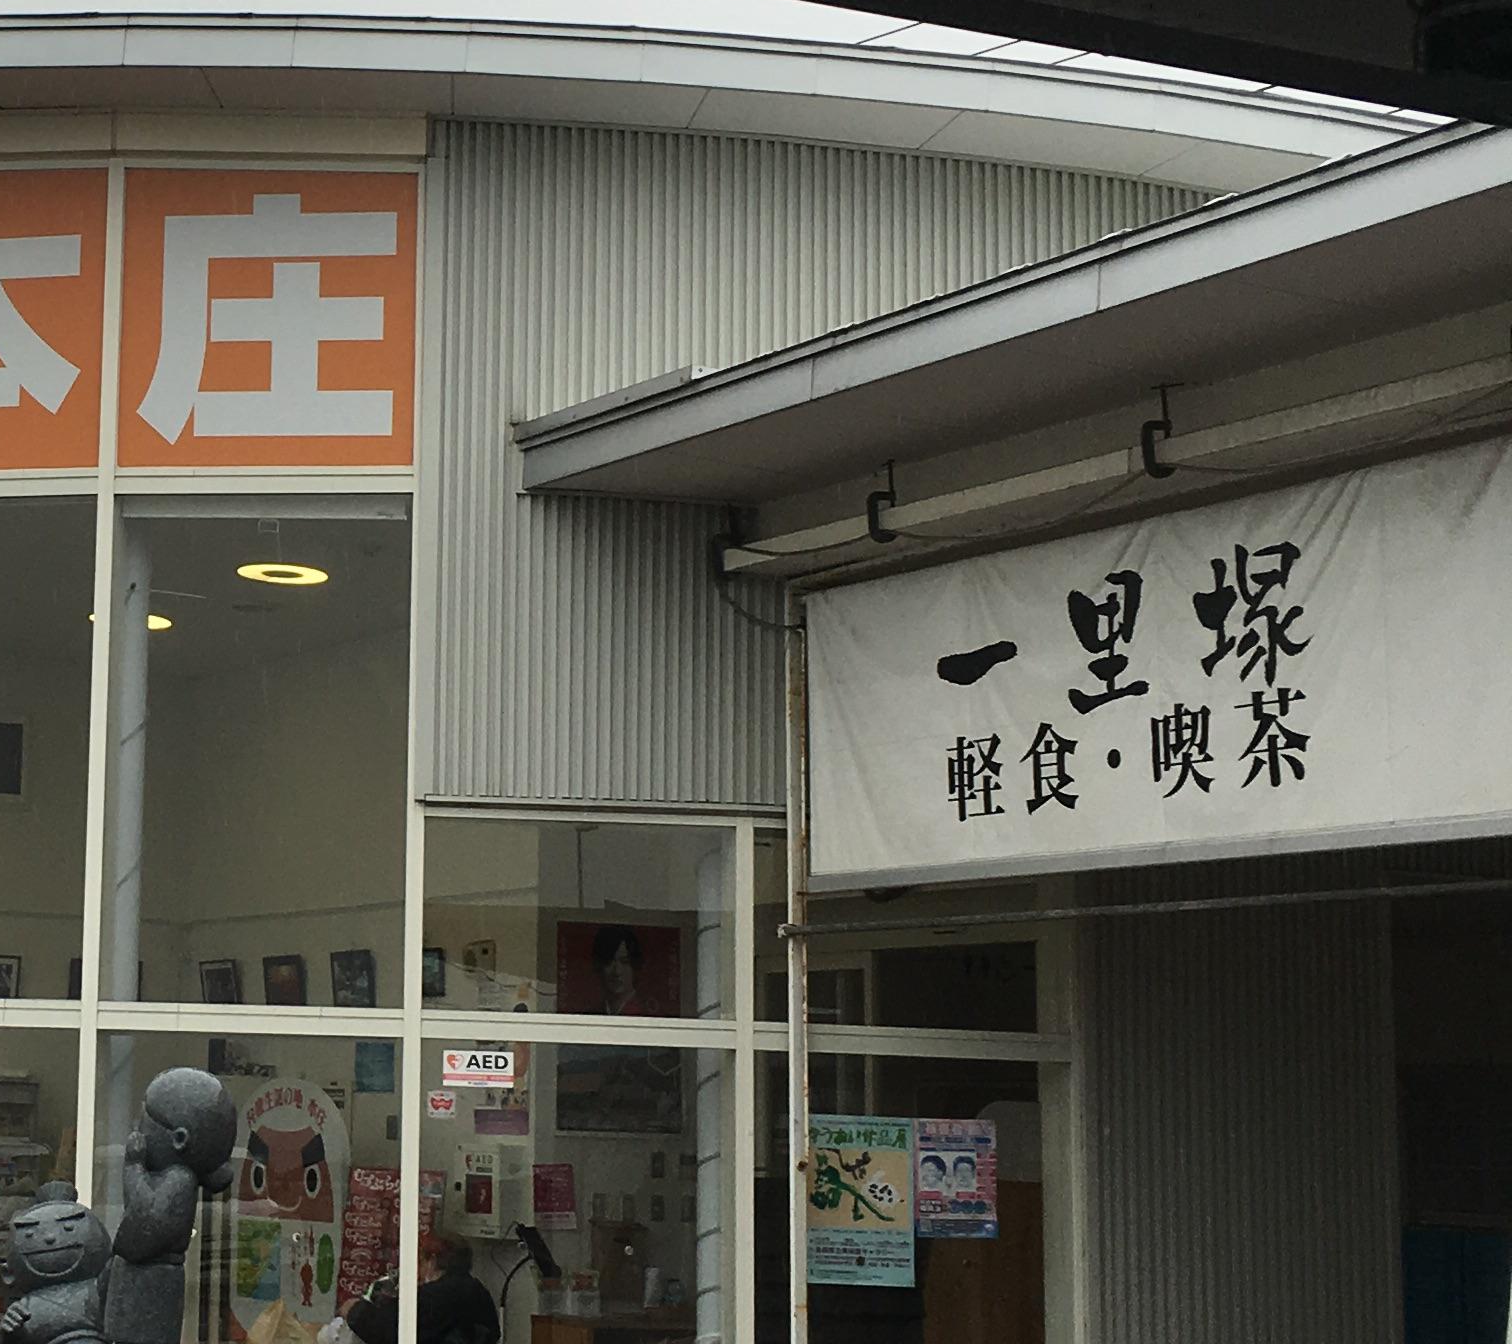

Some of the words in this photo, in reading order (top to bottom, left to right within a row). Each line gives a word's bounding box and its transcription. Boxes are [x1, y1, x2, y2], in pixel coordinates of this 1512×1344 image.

[937, 541, 1314, 714] 一里塚
[946, 687, 1311, 822] 軽食・喫茶
[466, 1054, 509, 1070] AED
